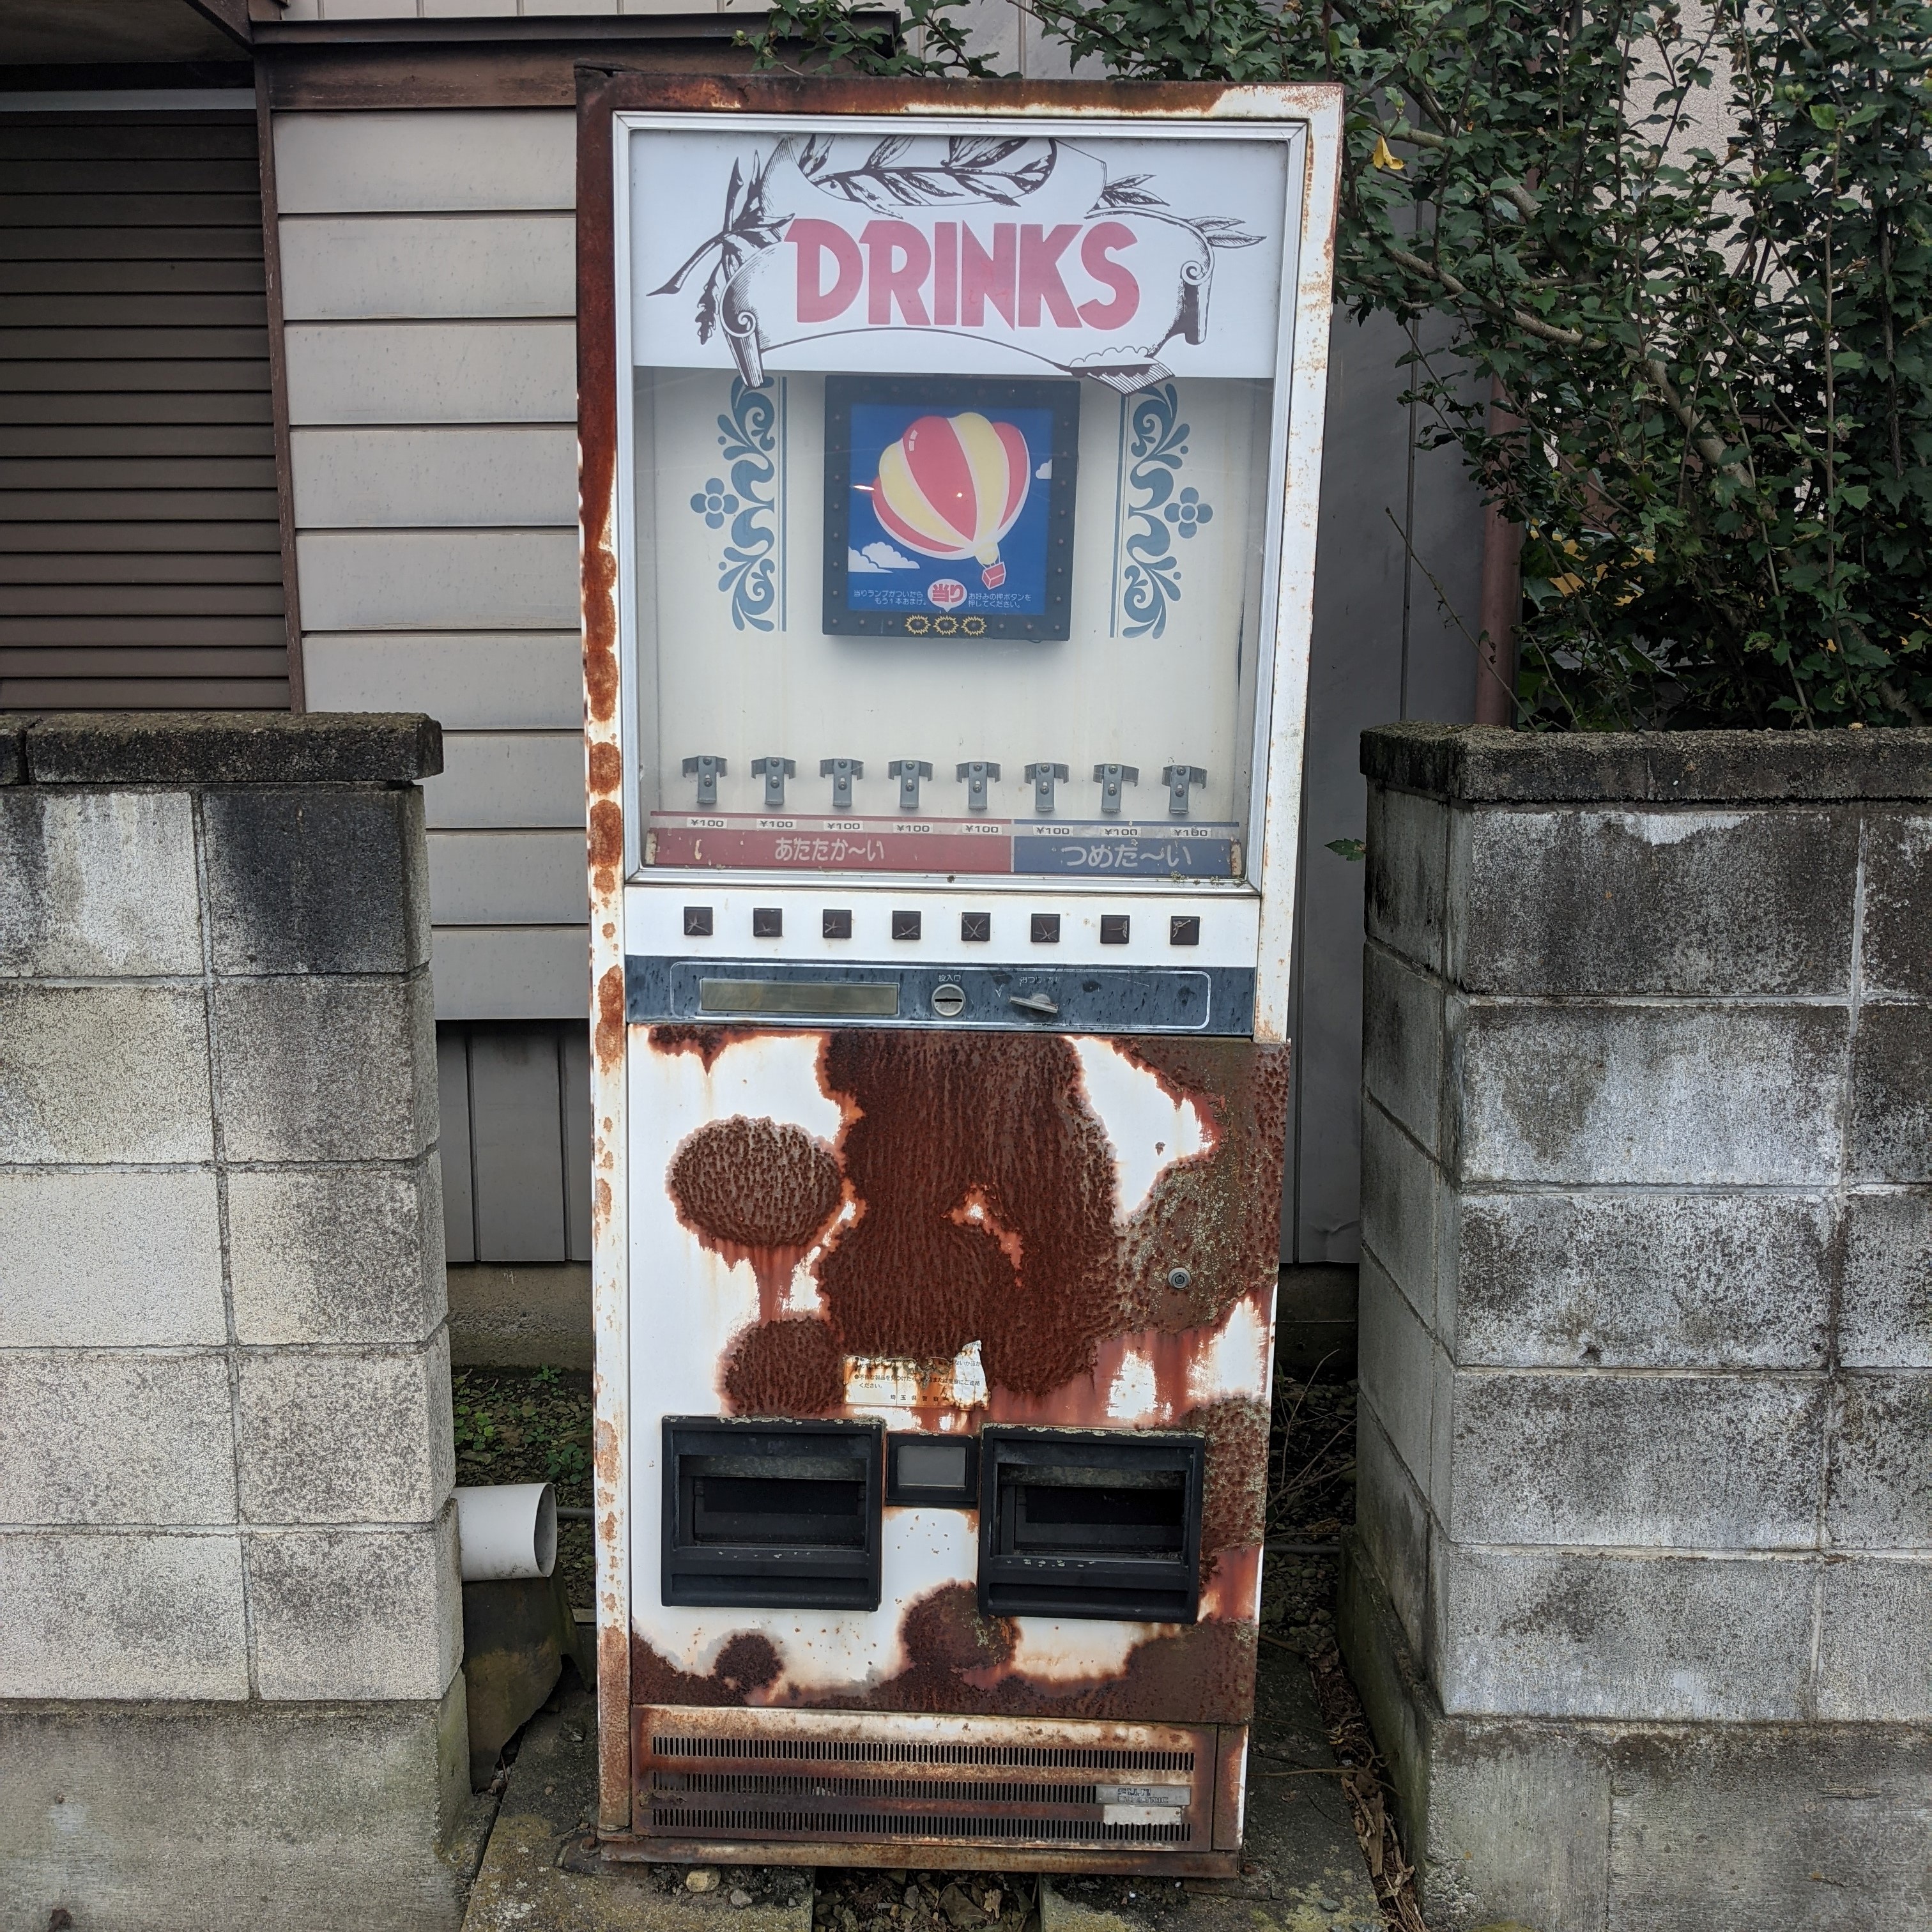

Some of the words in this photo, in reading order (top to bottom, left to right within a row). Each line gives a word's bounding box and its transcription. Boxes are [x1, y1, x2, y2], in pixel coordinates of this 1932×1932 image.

[785, 218, 1140, 330] DRINKS
[854, 590, 923, 598] 当りランプがついたら
[931, 583, 963, 602] 当り
[969, 593, 1031, 601] お好みの押ボタンを
[691, 819, 724, 827] ¥100
[760, 820, 793, 829] ¥100
[897, 824, 930, 832] ¥100
[965, 825, 999, 833] ¥100
[1036, 827, 1070, 835] ¥100
[1105, 828, 1138, 836] ¥100
[1174, 829, 1208, 837] ¥100
[1117, 1788, 1151, 1796] FUJI
